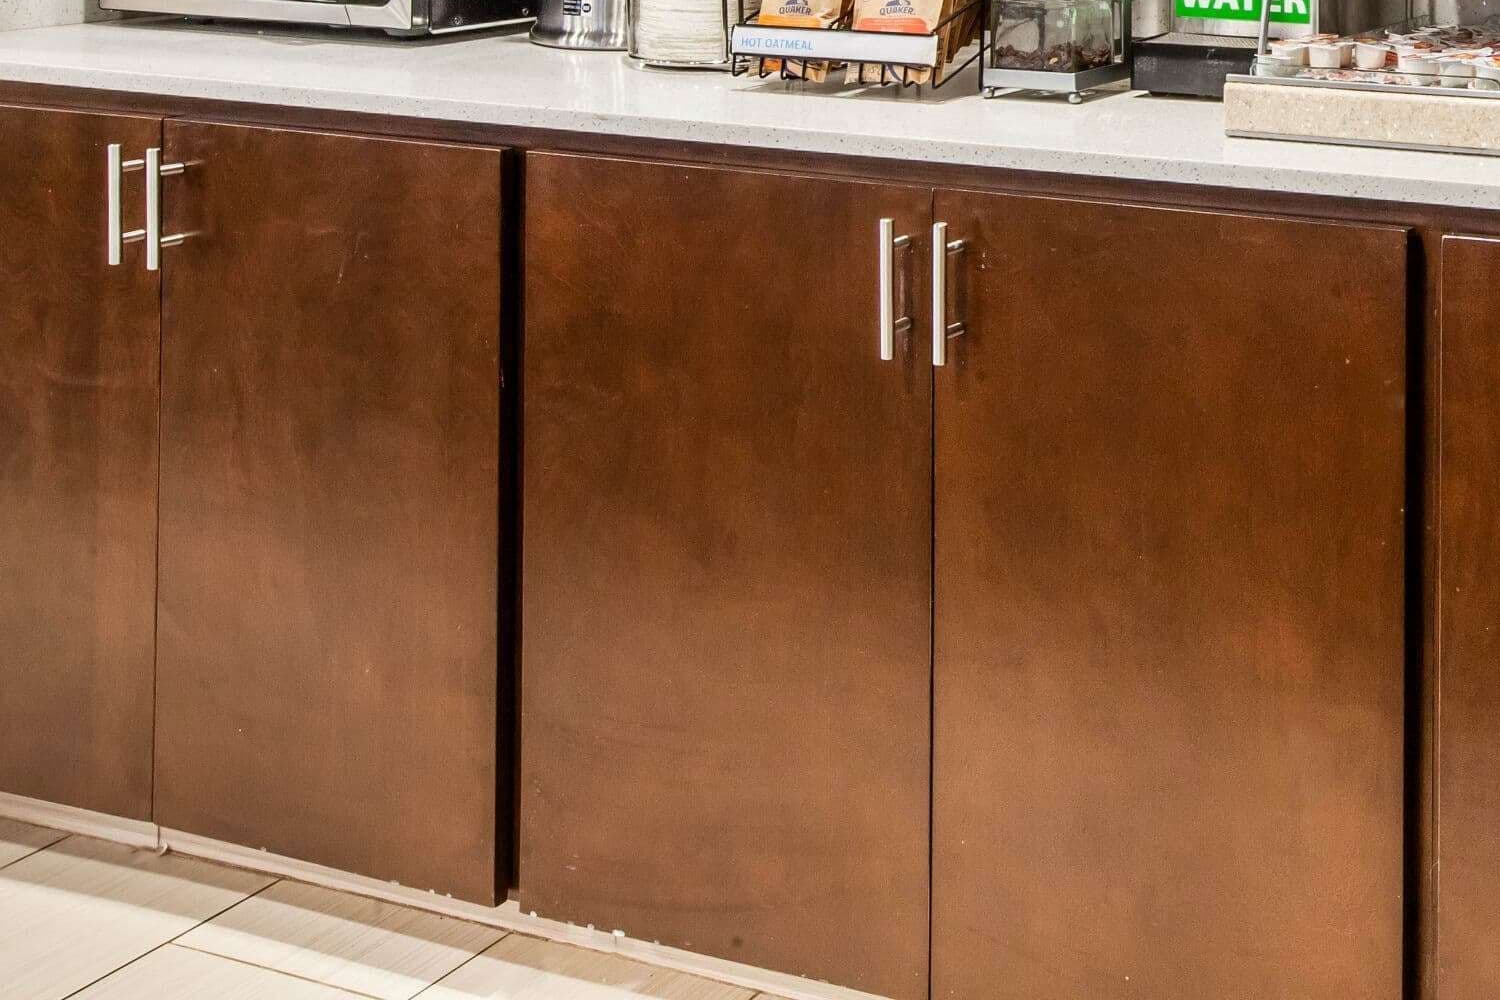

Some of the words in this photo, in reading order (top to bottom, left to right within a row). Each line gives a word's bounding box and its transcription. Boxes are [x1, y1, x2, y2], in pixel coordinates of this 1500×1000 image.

[778, 6, 812, 15] QUAKER
[879, 7, 914, 15] QUAKER
[741, 37, 762, 47] HOT
[764, 38, 814, 51] OATMEAL
